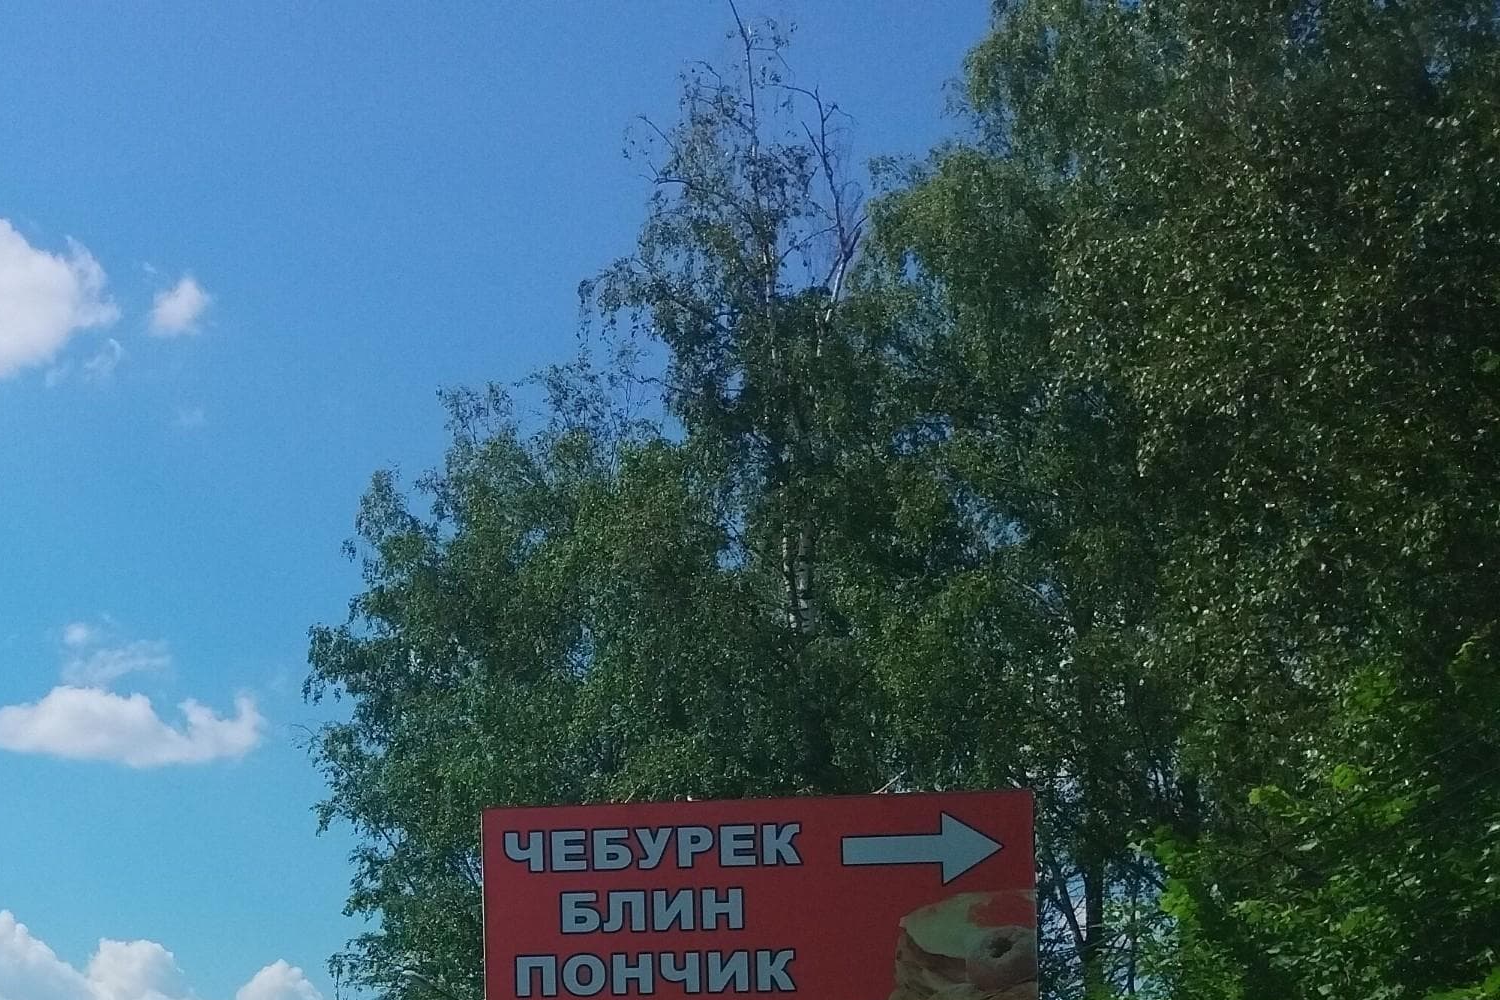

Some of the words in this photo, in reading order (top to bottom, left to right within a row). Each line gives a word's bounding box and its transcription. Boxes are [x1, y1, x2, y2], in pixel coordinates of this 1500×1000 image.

[503, 822, 802, 873] ЧЕБУРЕК
[561, 887, 744, 934] БЛИН
[515, 949, 796, 997] ПОНЧИК
